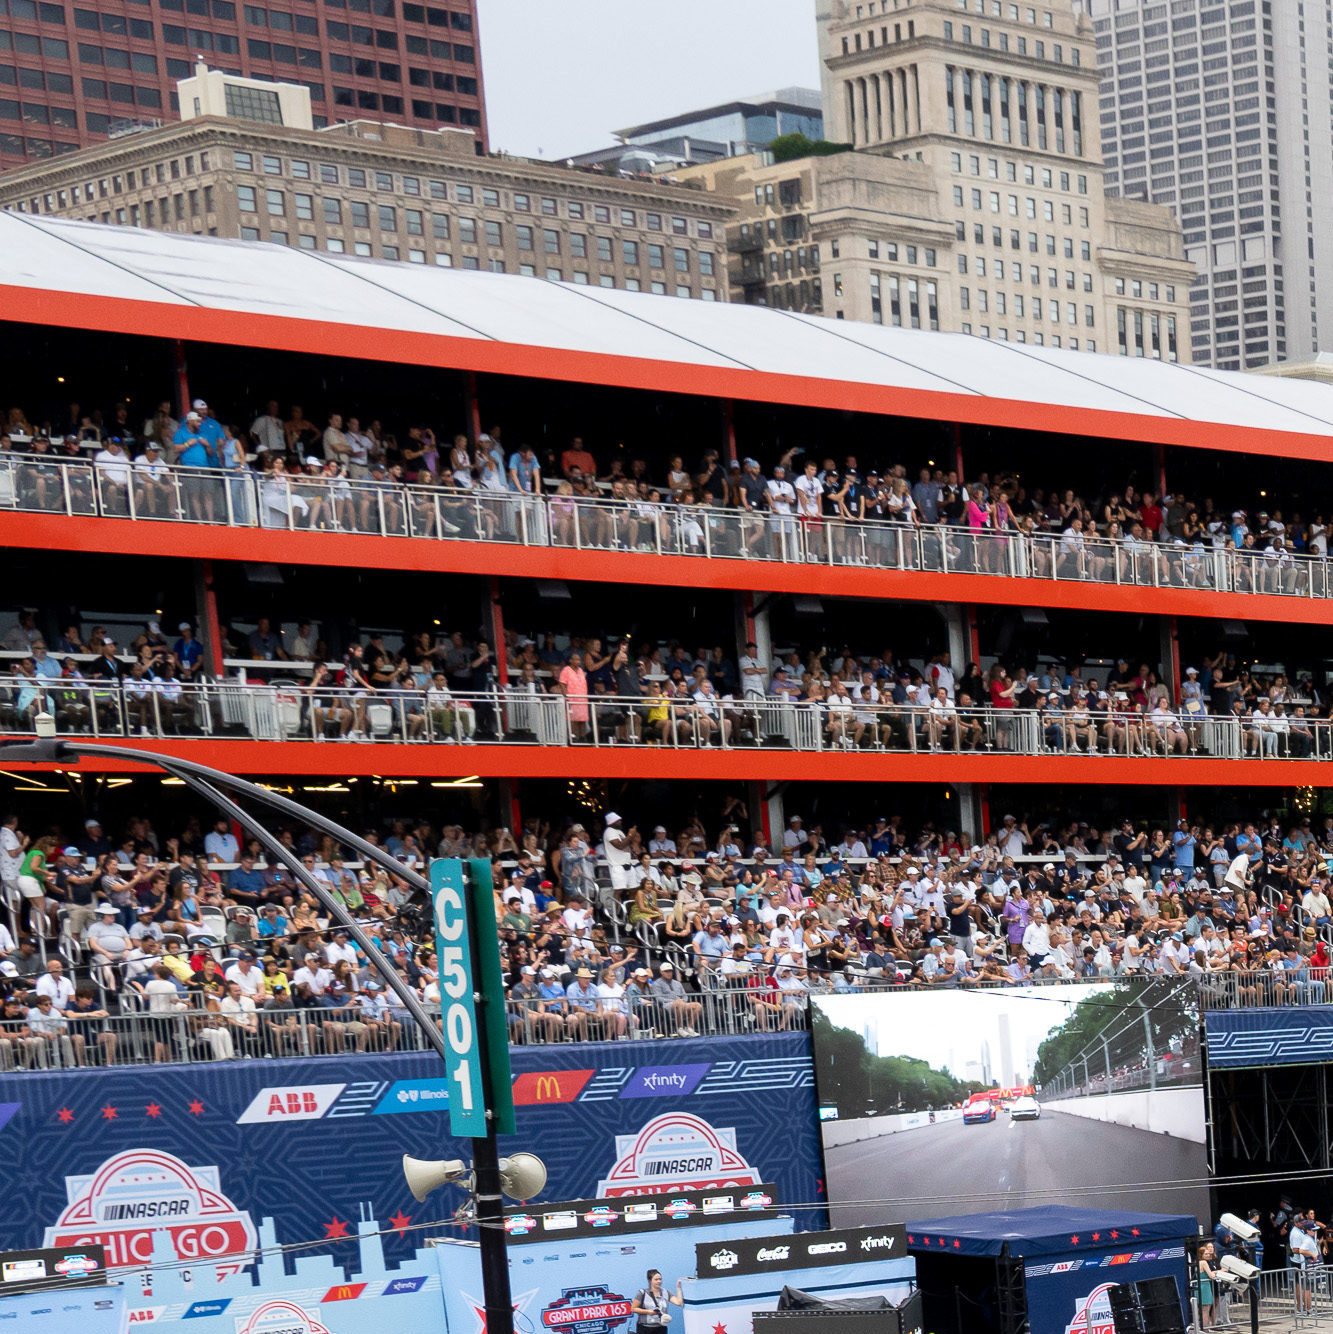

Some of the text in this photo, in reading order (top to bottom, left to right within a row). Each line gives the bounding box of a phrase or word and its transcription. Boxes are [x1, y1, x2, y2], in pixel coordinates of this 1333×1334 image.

[435, 886, 473, 1110] C501
[643, 1072, 687, 1090] xfinity
[419, 1089, 449, 1100] Illinois
[267, 1092, 318, 1115] ABB
[661, 1157, 713, 1174] NASCAR
[125, 1200, 189, 1220] NASCAR
[860, 1235, 895, 1251] xfinity
[710, 1253, 738, 1267] BUSCH
[1056, 1263, 1069, 1271] ABB
[129, 1310, 154, 1322] ABB
[549, 1304, 627, 1324] GRANT PARK 165
